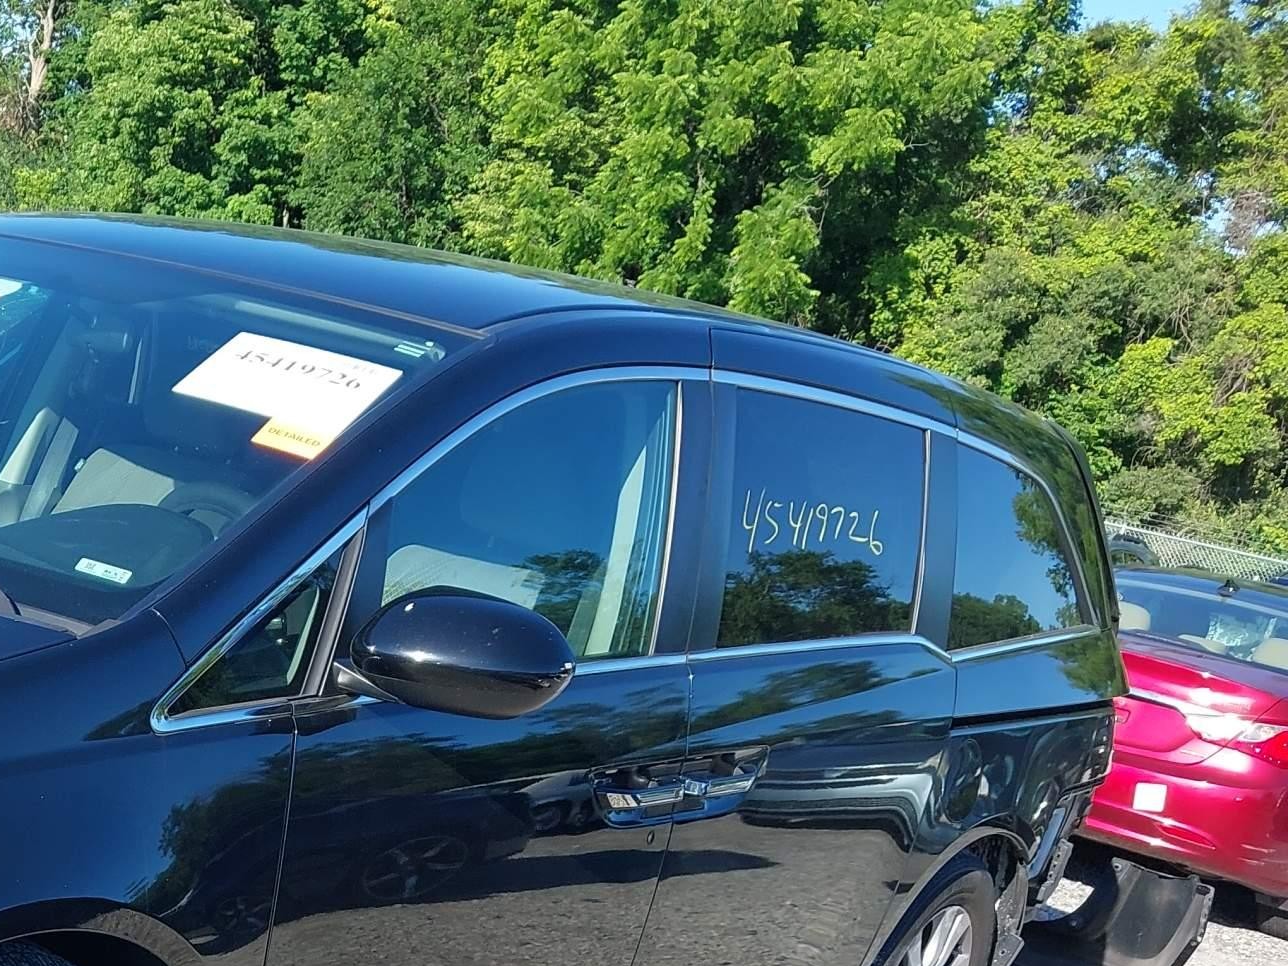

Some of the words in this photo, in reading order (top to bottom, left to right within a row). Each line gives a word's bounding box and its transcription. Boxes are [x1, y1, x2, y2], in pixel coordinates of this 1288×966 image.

[234, 349, 362, 390] 45419726
[267, 426, 322, 447] DETAILED
[742, 487, 884, 556] 45419726
